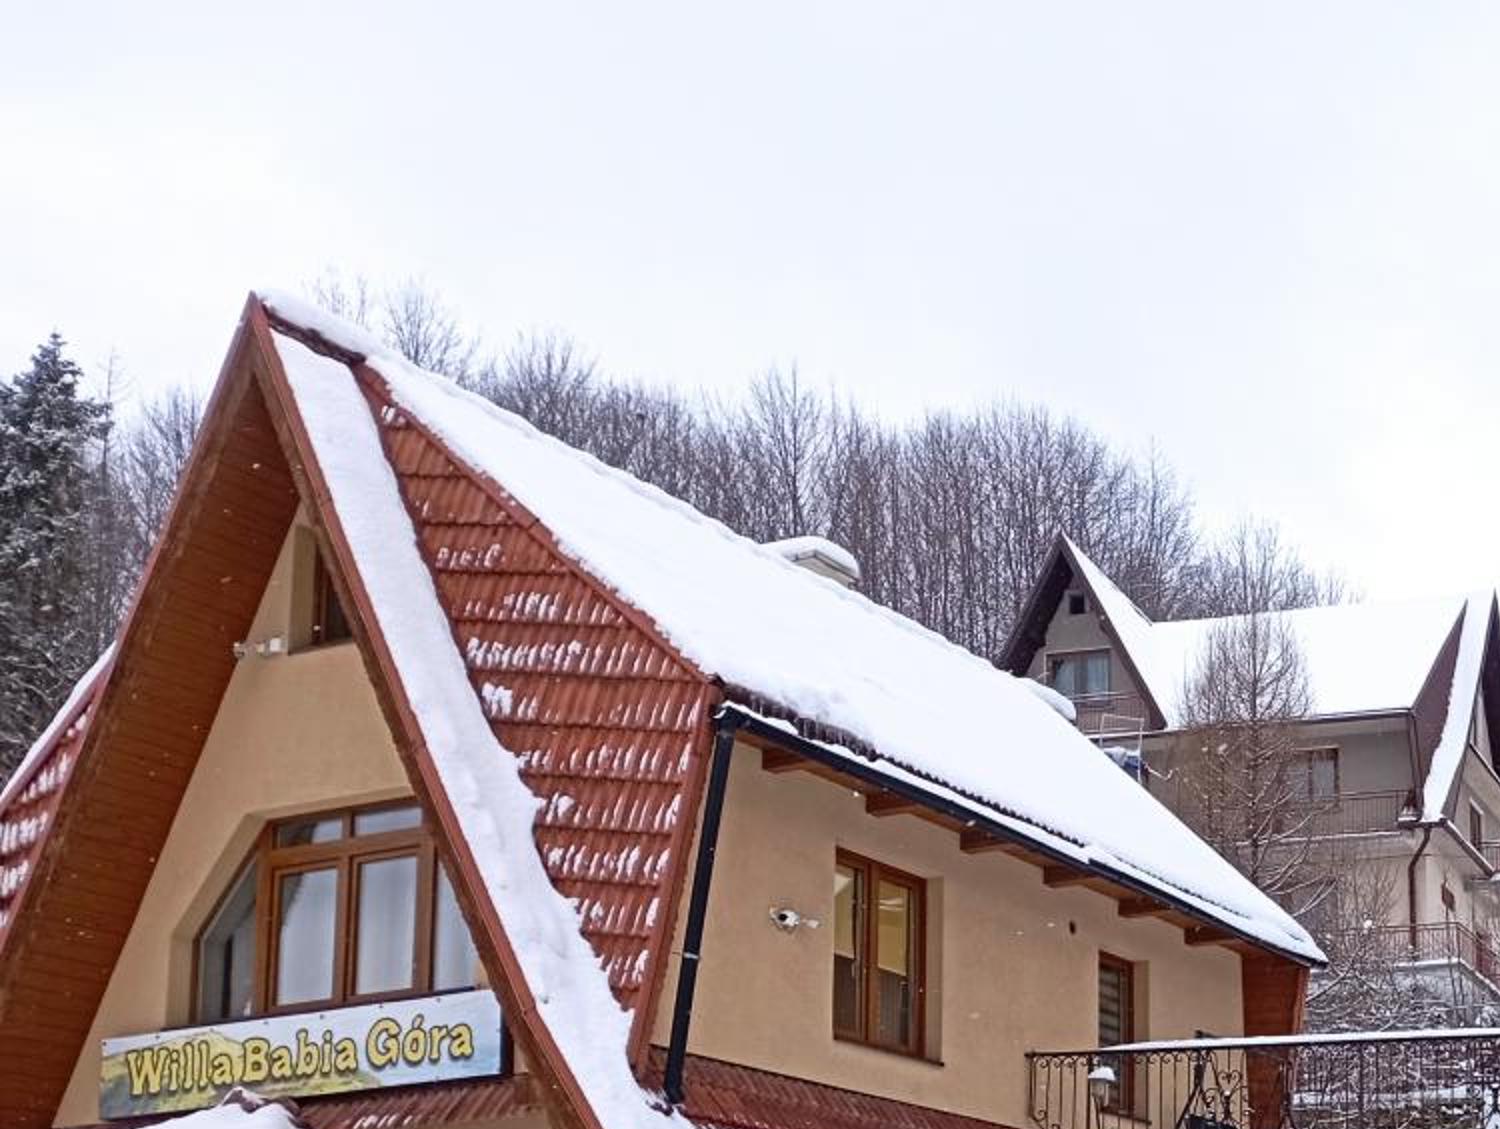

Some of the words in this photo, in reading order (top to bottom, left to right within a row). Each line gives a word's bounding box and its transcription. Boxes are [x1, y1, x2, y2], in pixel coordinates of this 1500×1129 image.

[126, 1041, 234, 1096] Willa
[241, 1029, 358, 1083] Babia
[366, 1013, 474, 1068] Góra
